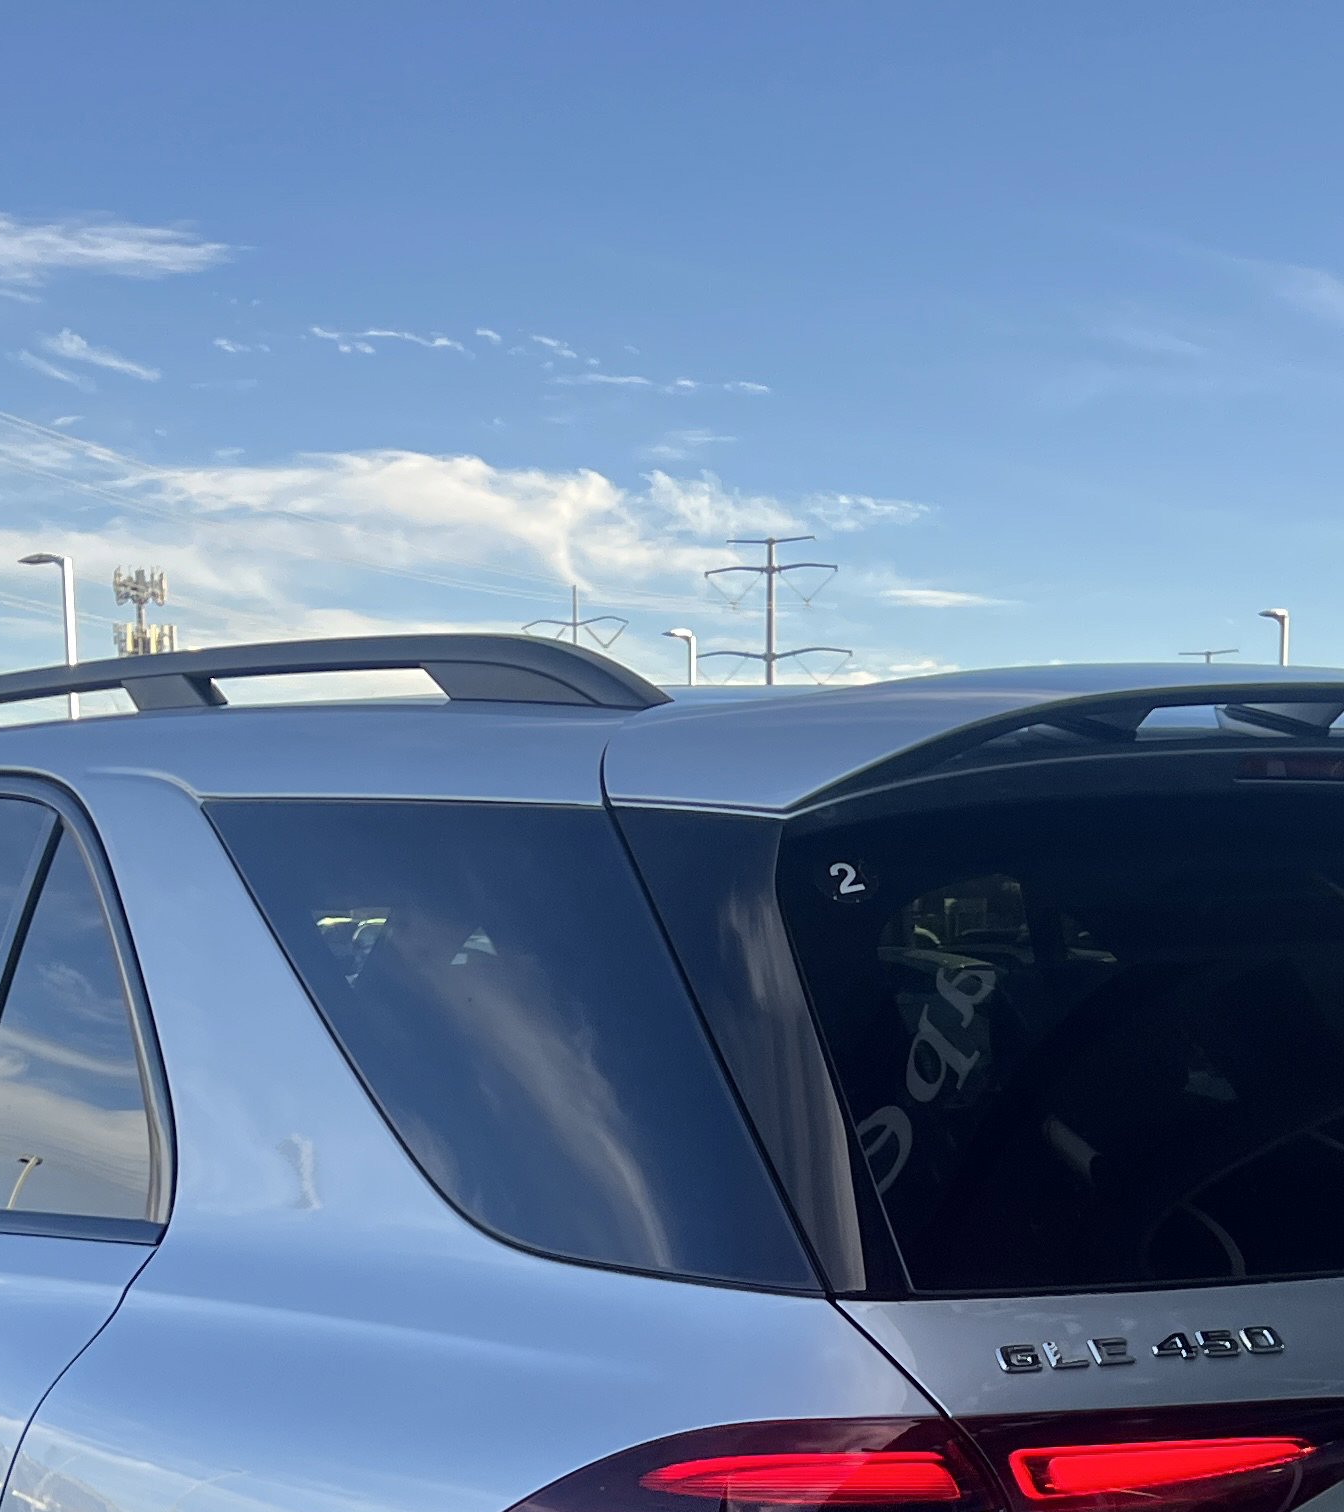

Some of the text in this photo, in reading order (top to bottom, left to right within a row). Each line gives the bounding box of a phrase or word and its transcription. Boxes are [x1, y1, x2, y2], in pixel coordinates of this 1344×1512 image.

[829, 862, 866, 894] 2
[995, 1325, 1286, 1374] GLE 450
